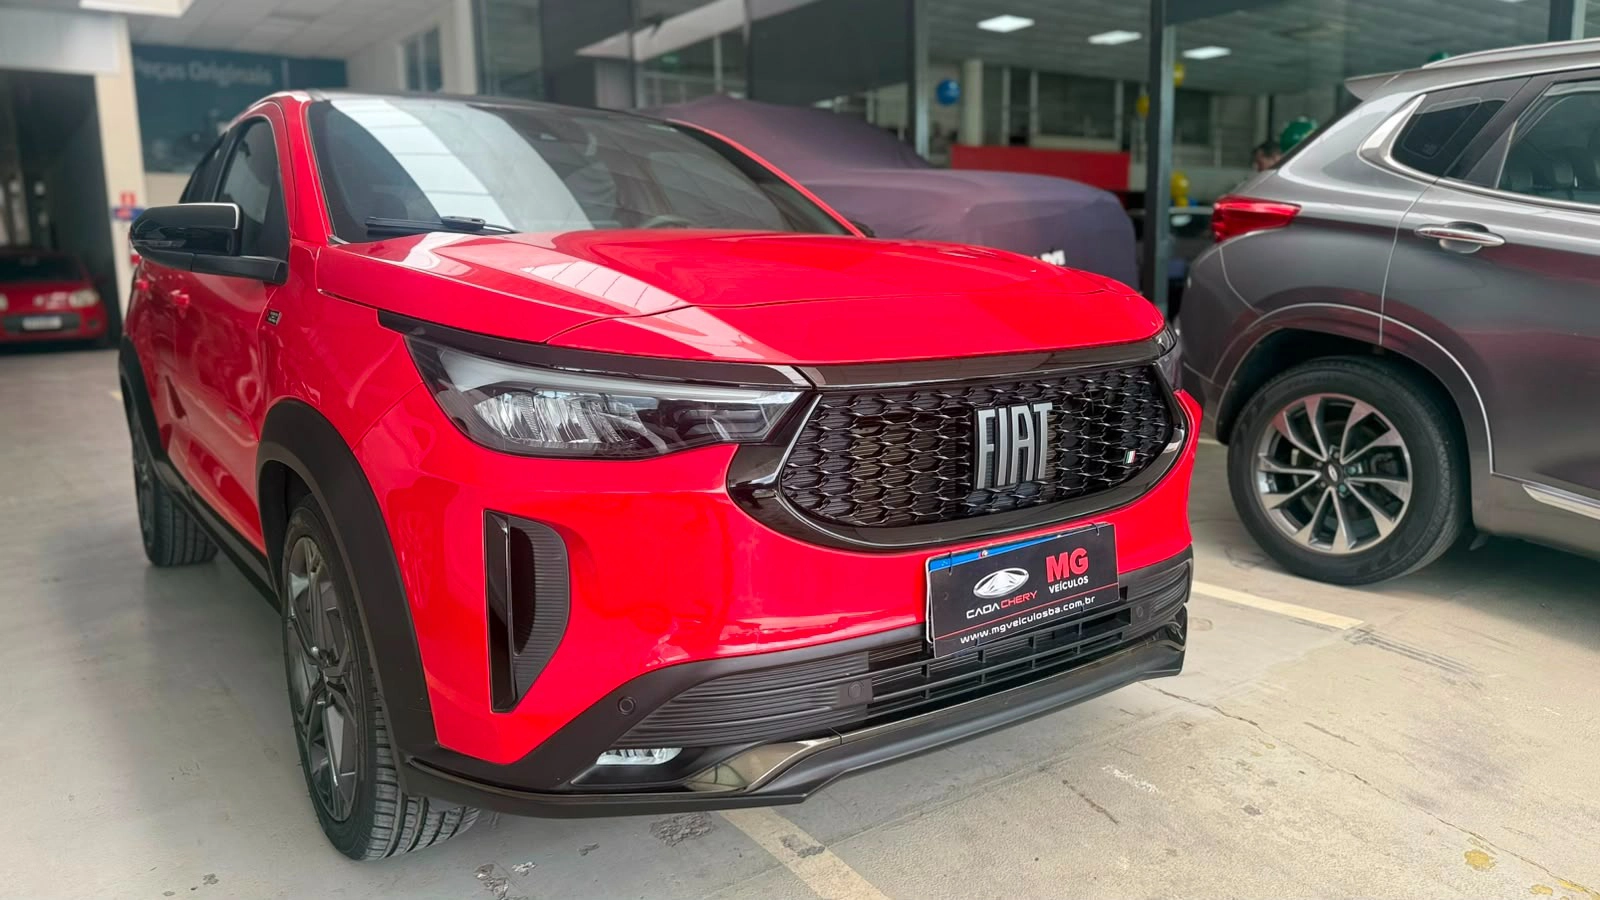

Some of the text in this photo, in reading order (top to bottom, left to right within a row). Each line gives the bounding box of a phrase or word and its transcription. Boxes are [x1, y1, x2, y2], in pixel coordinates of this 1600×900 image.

[977, 402, 1053, 490] FIAT
[1045, 548, 1089, 583] MG
[1000, 590, 1037, 607] CHERY
[1049, 575, 1089, 594] VEÍCULOS
[960, 595, 1096, 645] www.mgveiculosba.com.br
